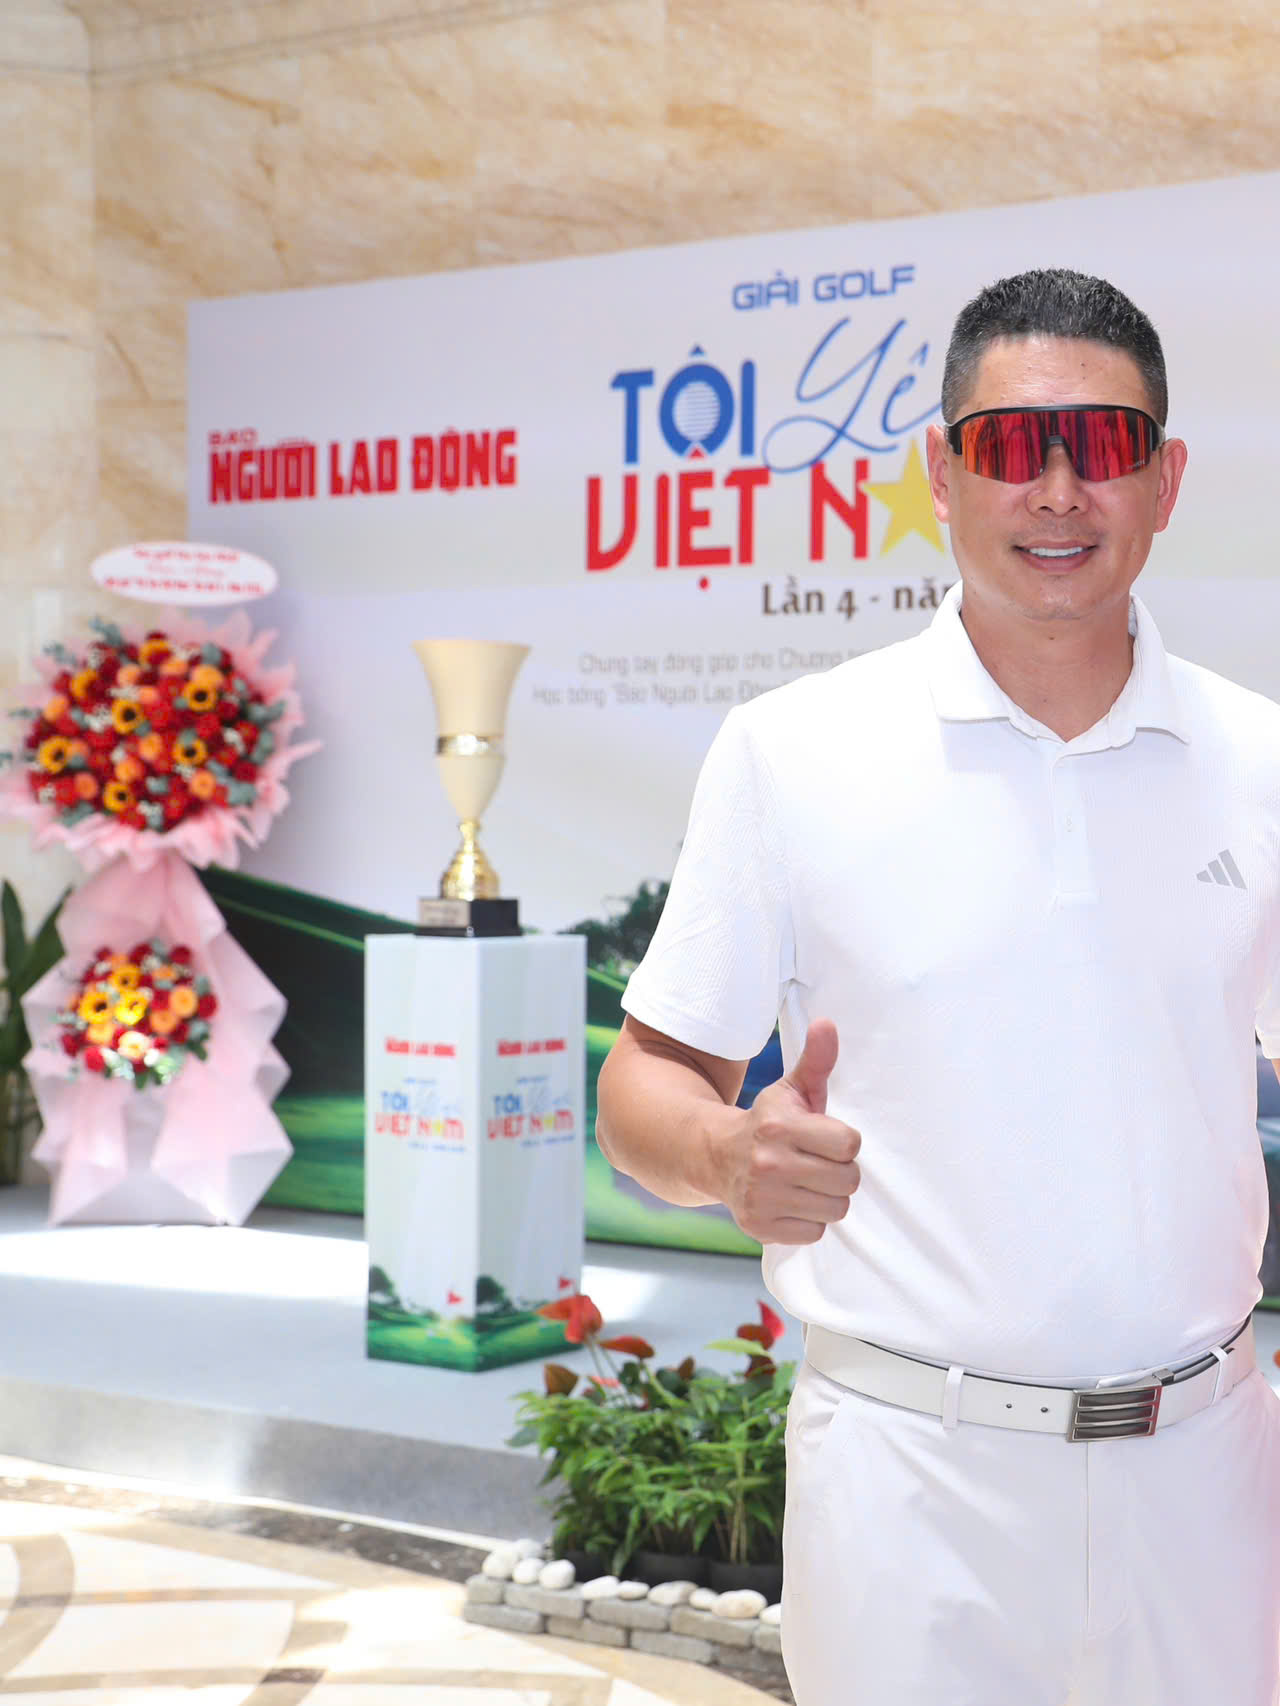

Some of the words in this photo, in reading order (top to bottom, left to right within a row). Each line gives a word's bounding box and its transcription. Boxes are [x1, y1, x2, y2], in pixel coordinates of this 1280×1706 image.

[731, 271, 799, 311] GIẢI
[814, 264, 915, 302] GOLF
[610, 343, 757, 466] TÔI
[762, 316, 943, 475] Yê
[208, 437, 318, 505] NGƯỜI
[329, 438, 398, 496] LAO
[411, 427, 517, 494] ĐỘNG
[586, 447, 770, 591] VIỆT
[762, 574, 824, 615] Lần
[836, 588, 858, 621] 4
